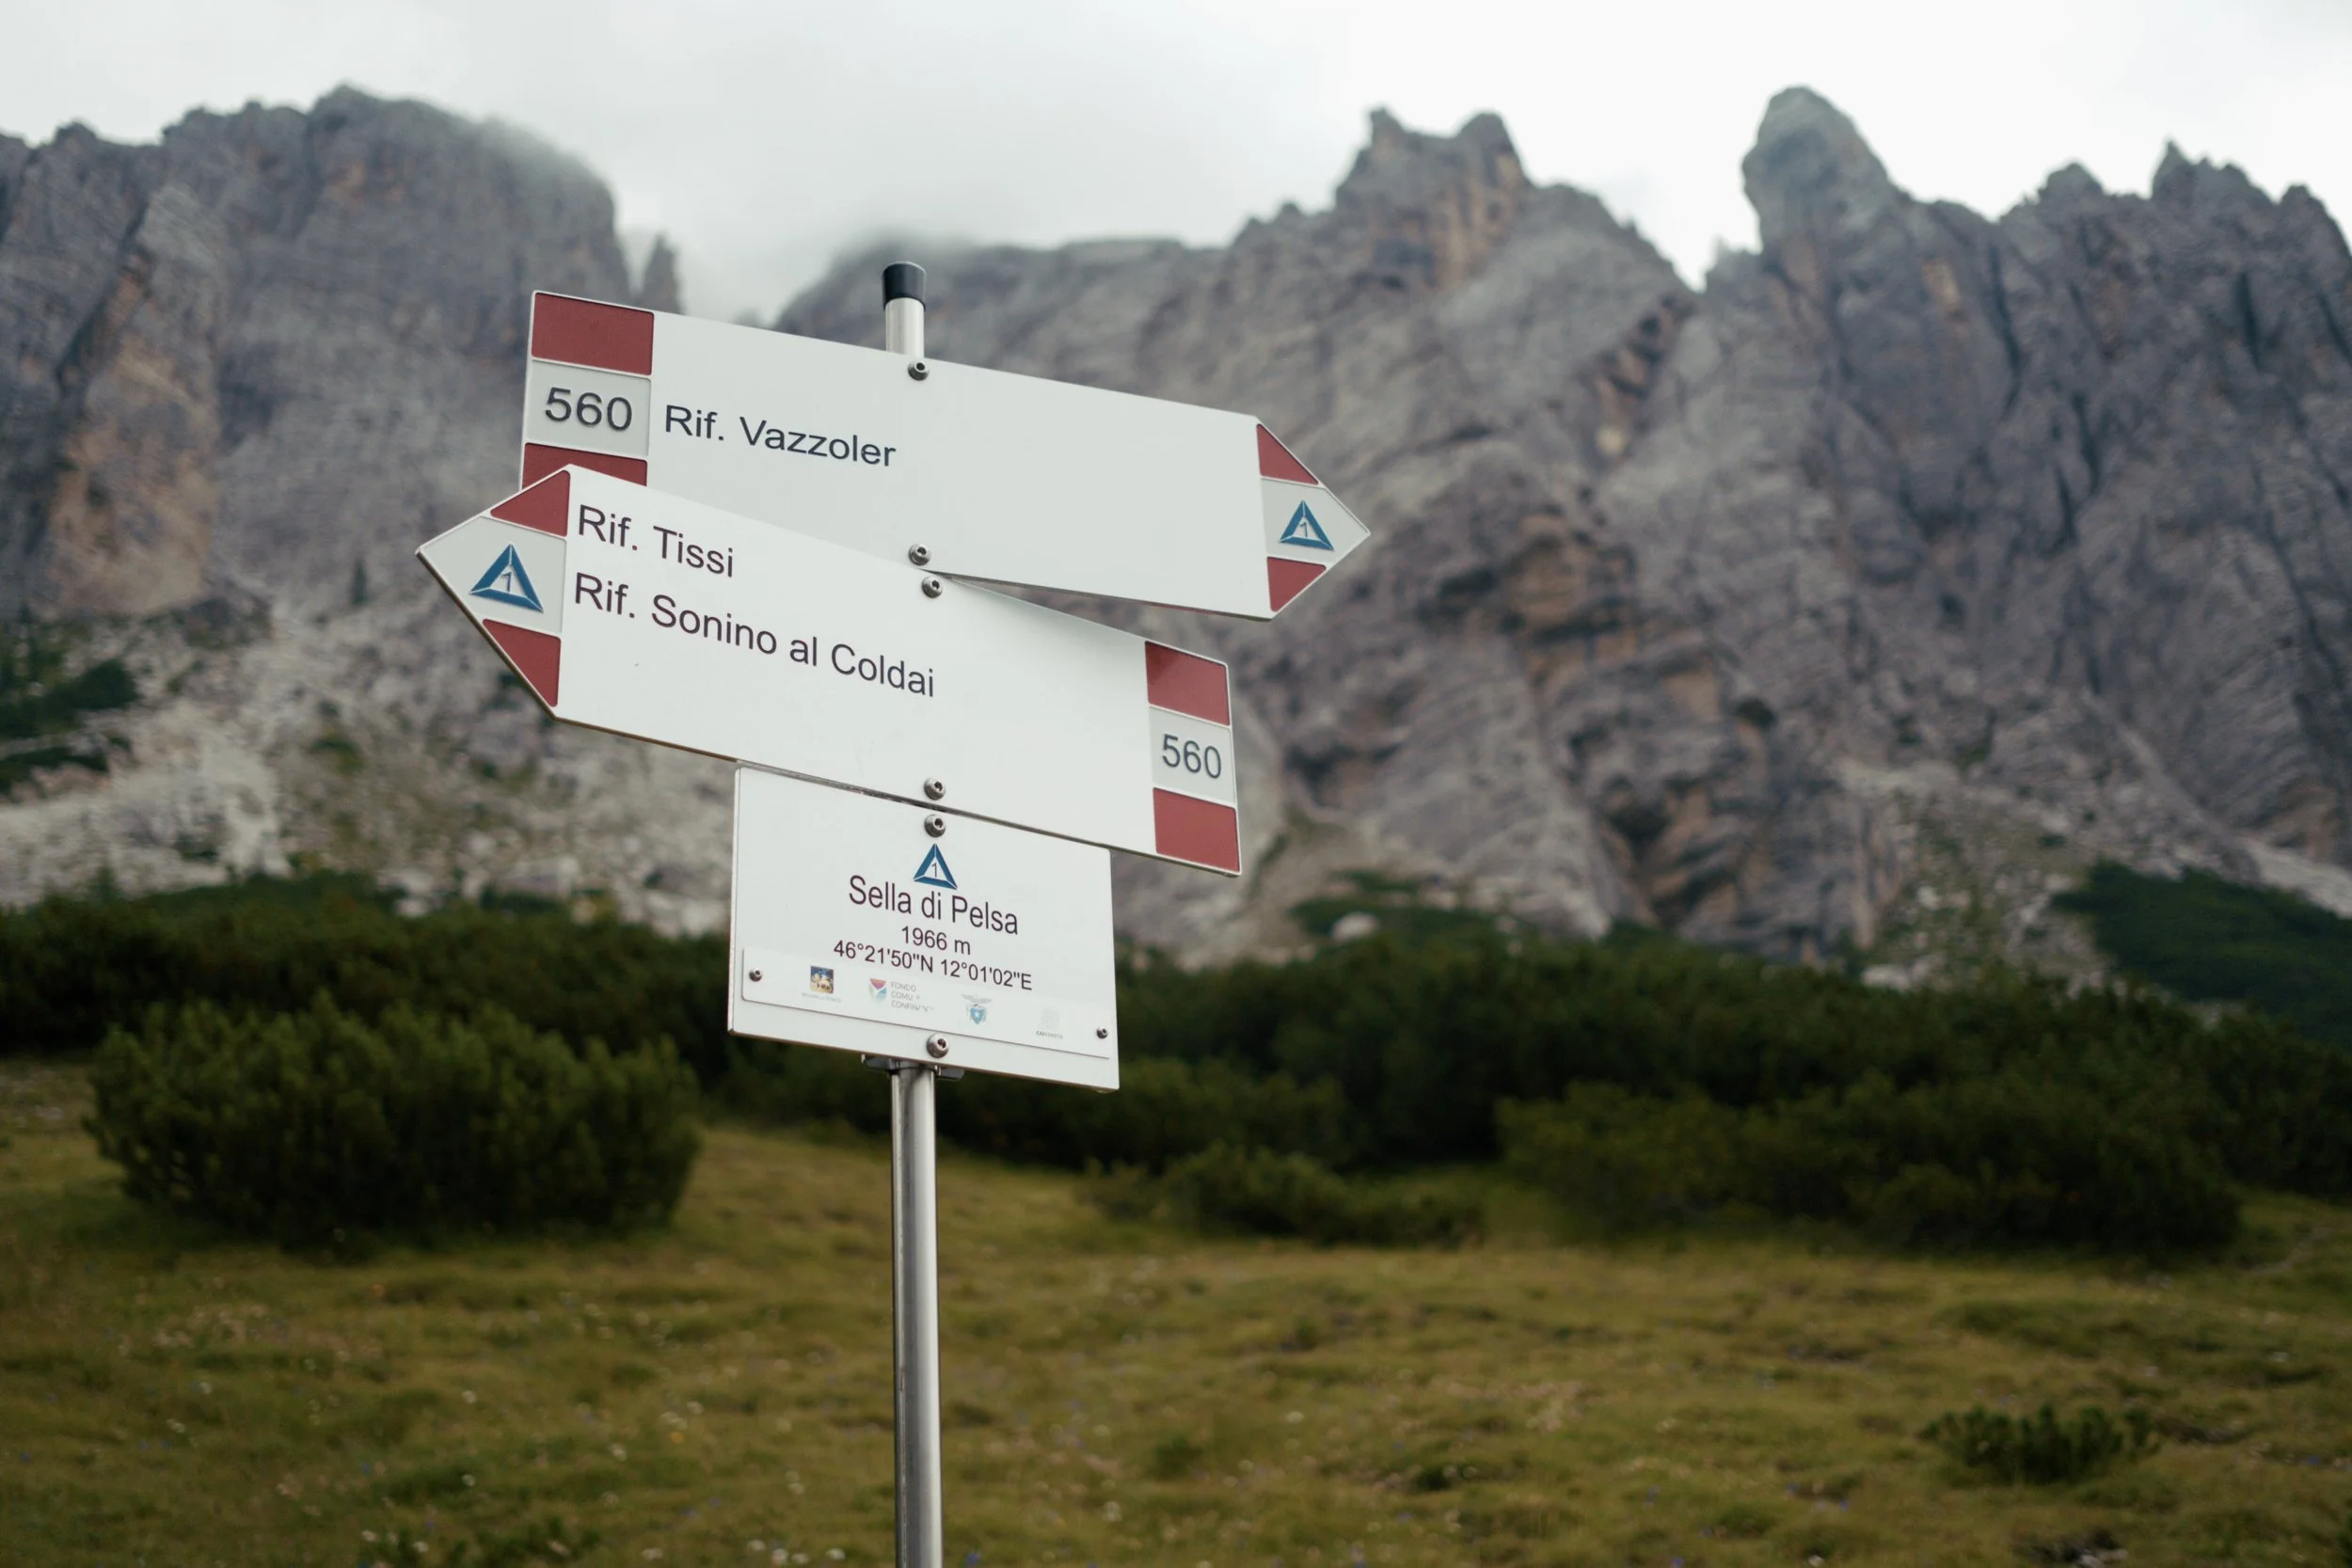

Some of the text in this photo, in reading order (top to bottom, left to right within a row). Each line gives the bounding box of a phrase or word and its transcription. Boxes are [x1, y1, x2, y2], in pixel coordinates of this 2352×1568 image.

[544, 387, 633, 433] 560
[665, 404, 897, 467] Rif. Vazzoler
[578, 503, 733, 578] Rif. Tissi
[1299, 522, 1309, 538] 1
[501, 571, 512, 593] 1
[575, 571, 934, 698] Rif. Sonino al Coldai
[1162, 733, 1222, 780] 560
[931, 862, 938, 878] 1
[849, 874, 1019, 936] Sella di Pelsa
[901, 926, 971, 956] 1966 m
